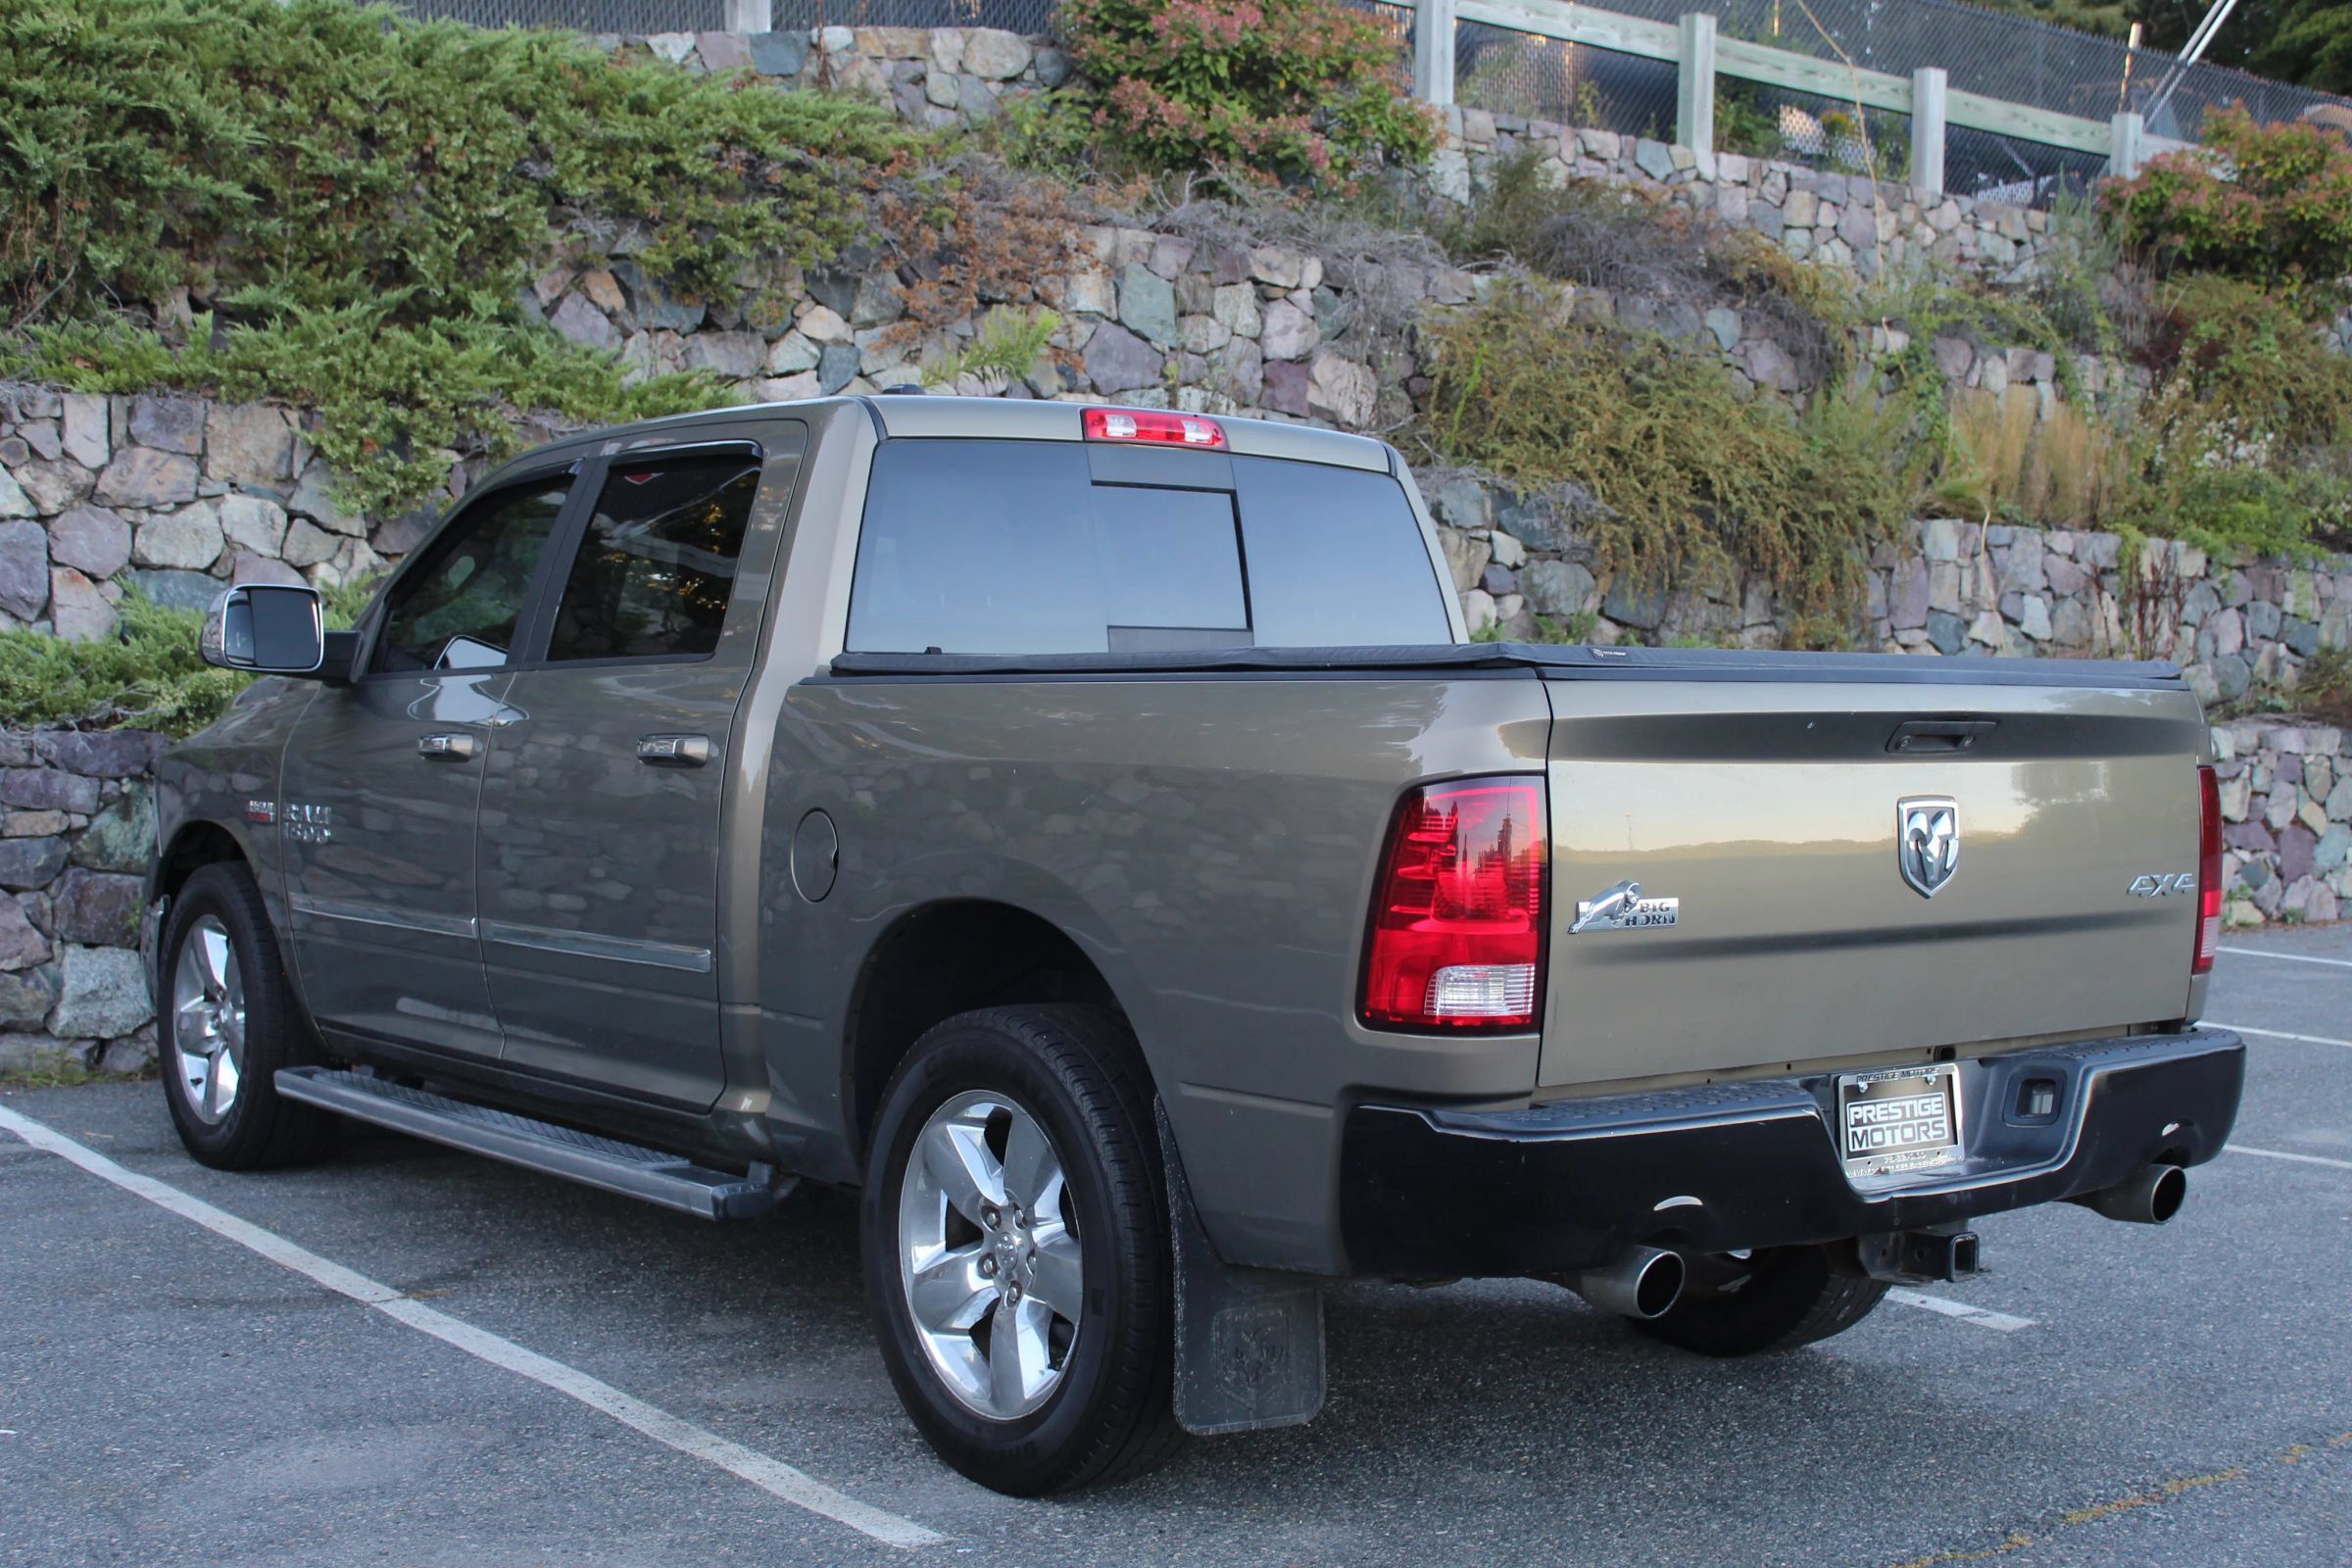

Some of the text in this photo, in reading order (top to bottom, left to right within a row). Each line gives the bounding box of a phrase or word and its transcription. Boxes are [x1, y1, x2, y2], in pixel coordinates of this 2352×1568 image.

[1640, 902, 1671, 913] BIG
[1625, 914, 1676, 927] HORN
[1856, 1067, 1939, 1083] PRESTIGE MOTORS
[1849, 1096, 1944, 1126] PRESTIGE
[1851, 1119, 1946, 1151] MOTORS
